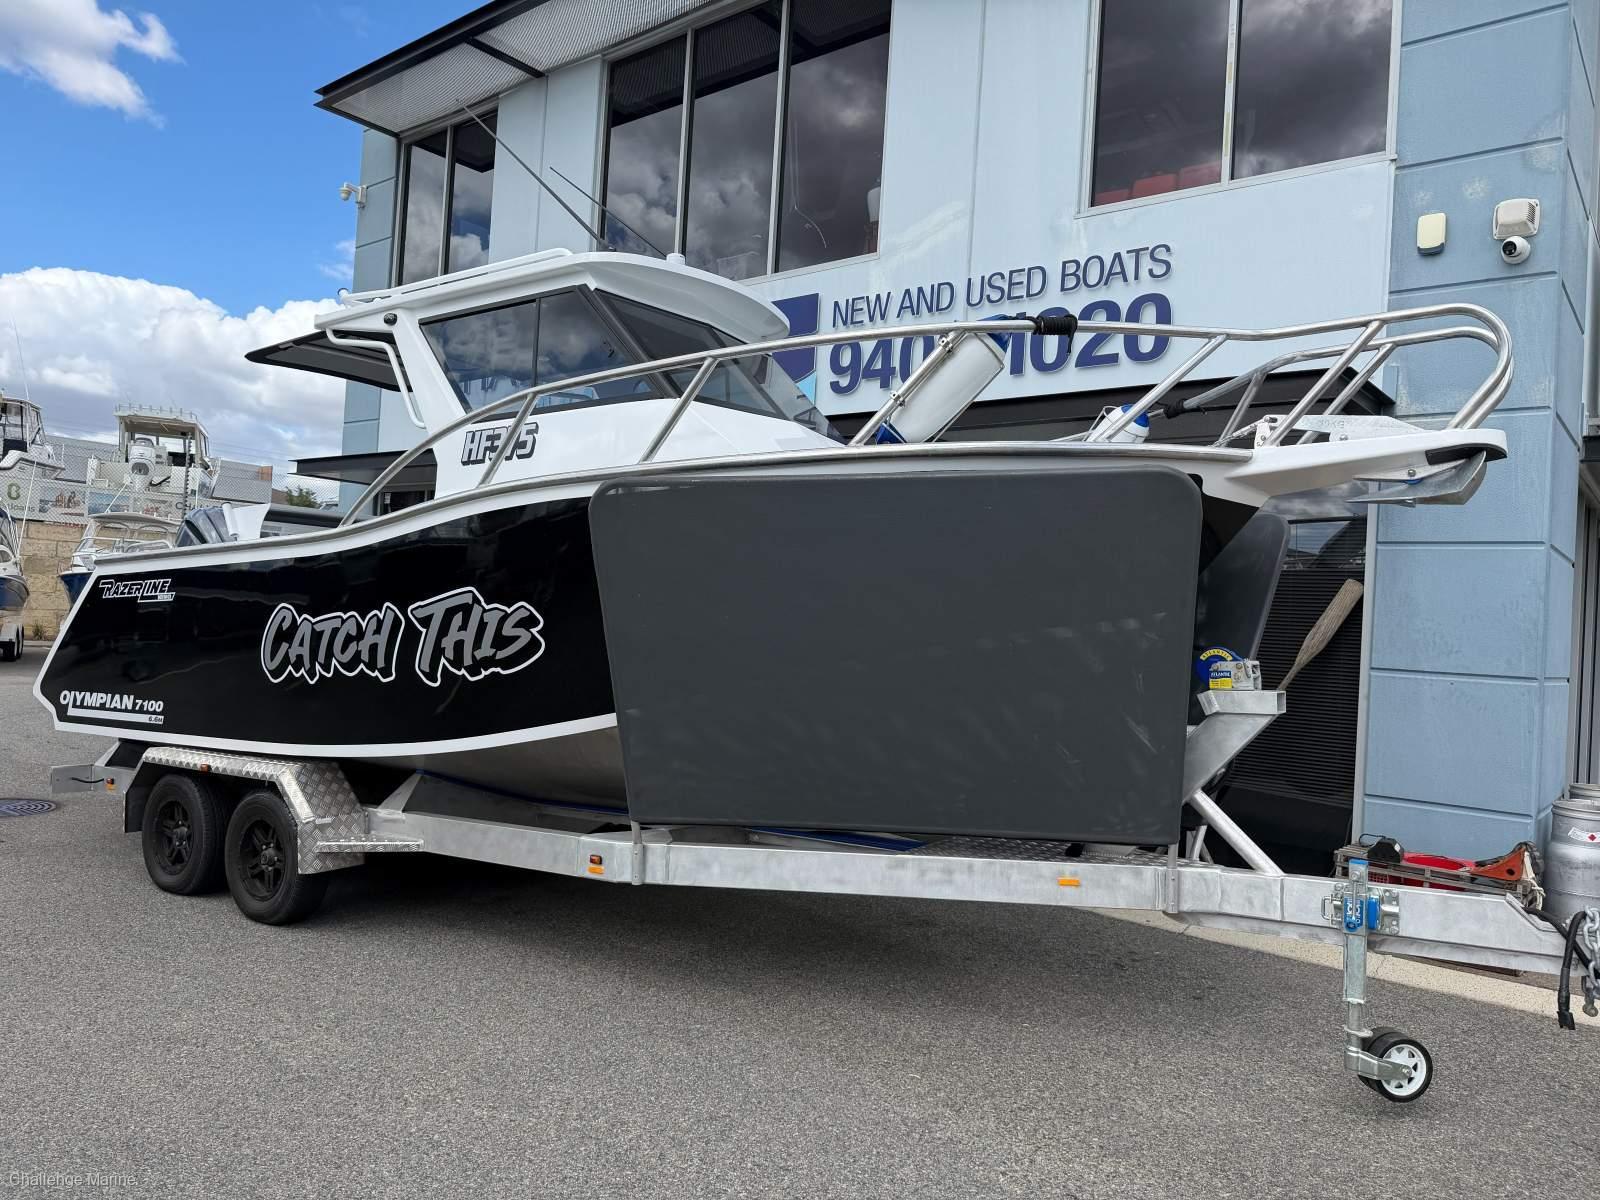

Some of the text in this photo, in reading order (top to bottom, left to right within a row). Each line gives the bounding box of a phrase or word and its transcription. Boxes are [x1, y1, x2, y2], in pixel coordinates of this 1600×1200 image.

[832, 243, 1173, 328] NEW AND USED BOATS
[829, 334, 942, 395] 940
[261, 586, 545, 687] CATCH THIS
[60, 690, 164, 712] OLYMPIAN 7100
